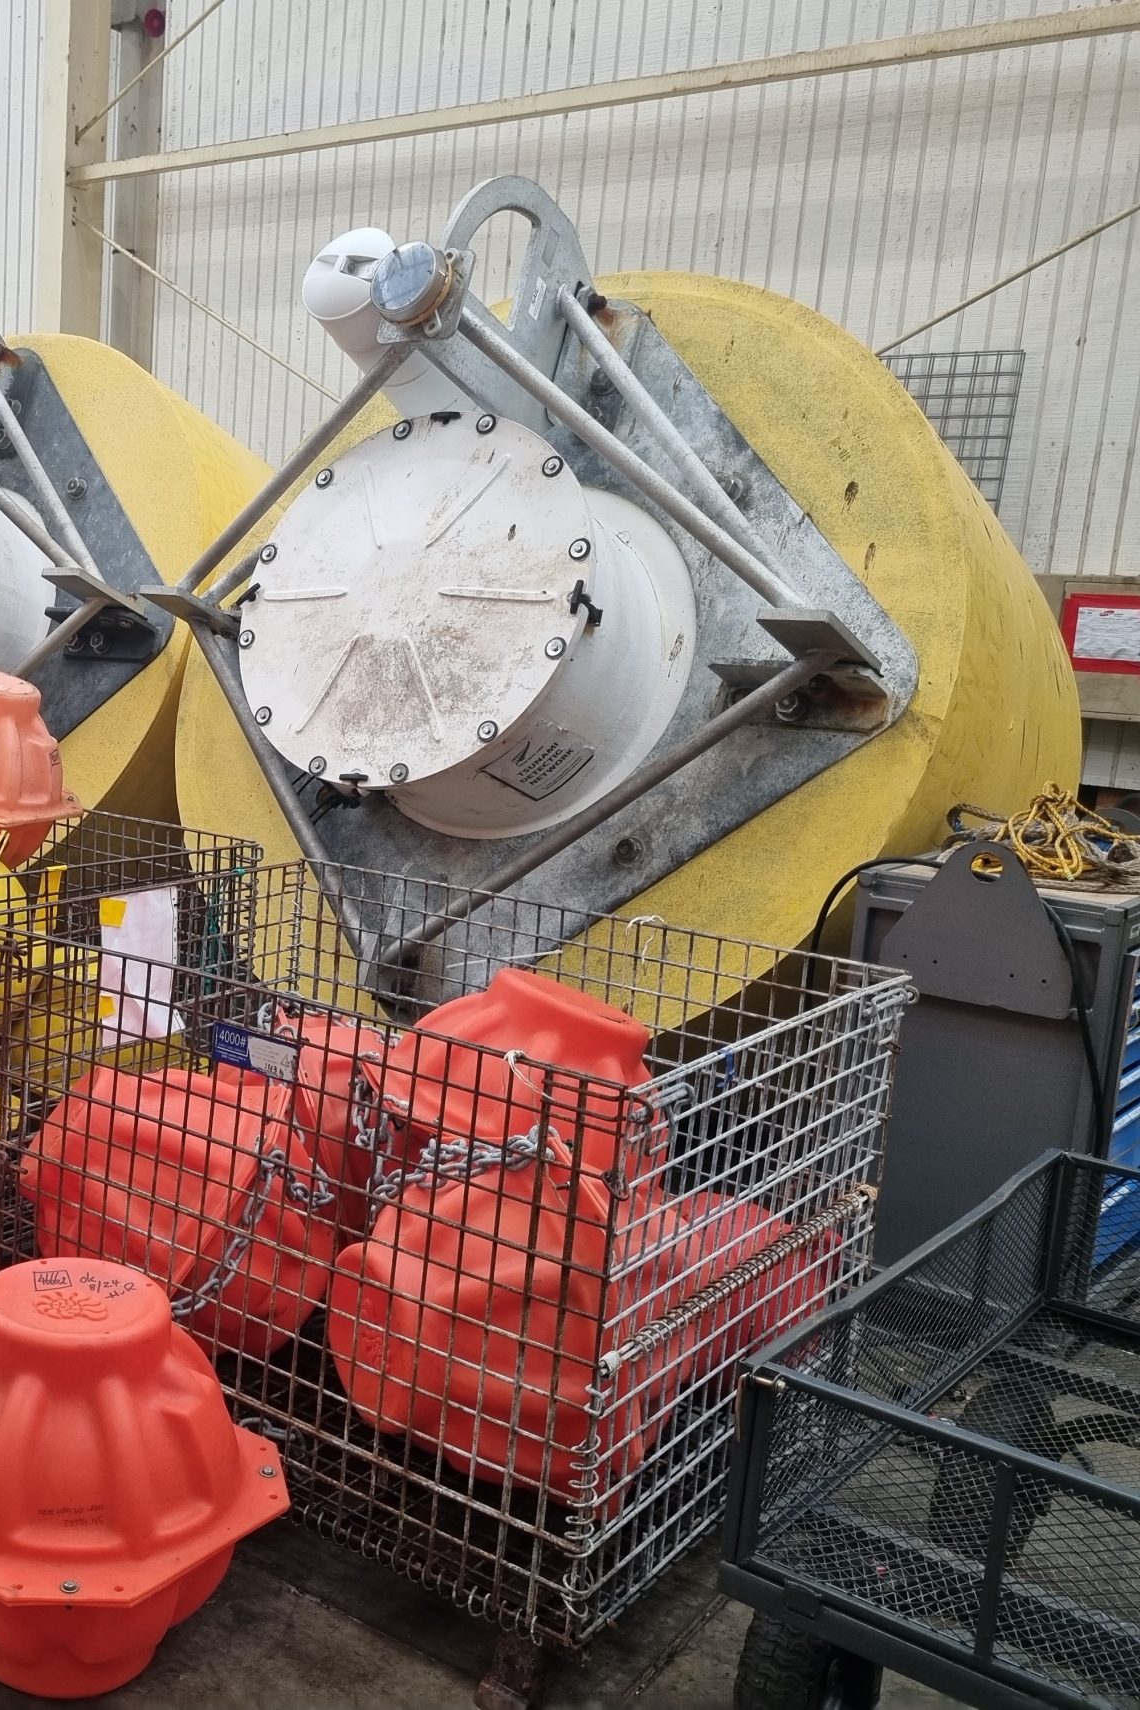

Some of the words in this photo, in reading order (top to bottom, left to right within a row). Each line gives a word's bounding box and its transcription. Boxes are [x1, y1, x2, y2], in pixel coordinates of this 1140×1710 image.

[516, 742, 559, 777] TSUNAMI
[529, 748, 575, 787] NETWORK
[219, 1028, 247, 1048] 4000#
[37, 1271, 68, 1286] 46662
